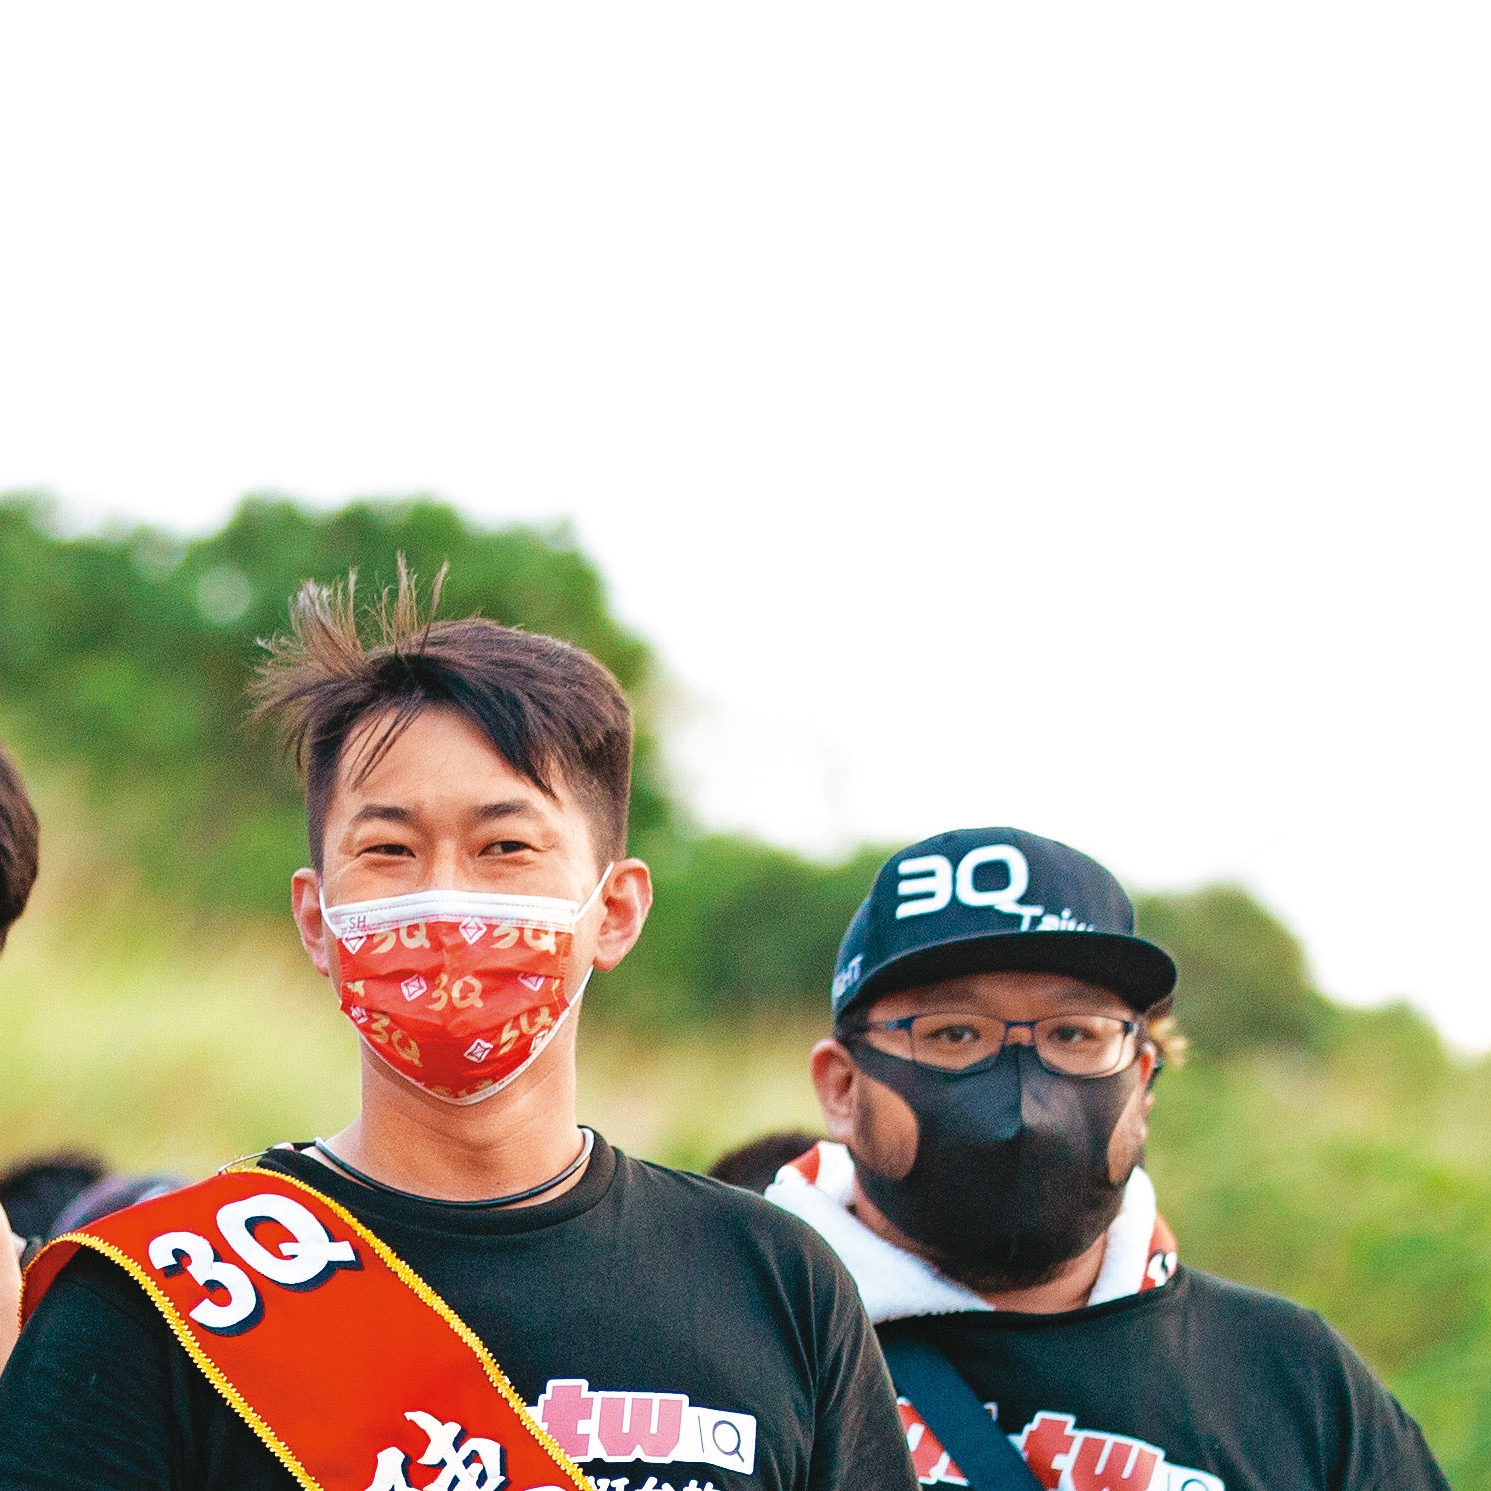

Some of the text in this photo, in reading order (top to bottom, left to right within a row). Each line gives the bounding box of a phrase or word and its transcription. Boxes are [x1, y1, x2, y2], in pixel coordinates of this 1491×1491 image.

[896, 844, 1030, 920] 3Q
[372, 921, 431, 954] 3Q
[491, 921, 557, 955] 3Q
[427, 974, 484, 1011] 3Q
[372, 1012, 423, 1067] 3Q
[148, 1193, 359, 1332] 3Q
